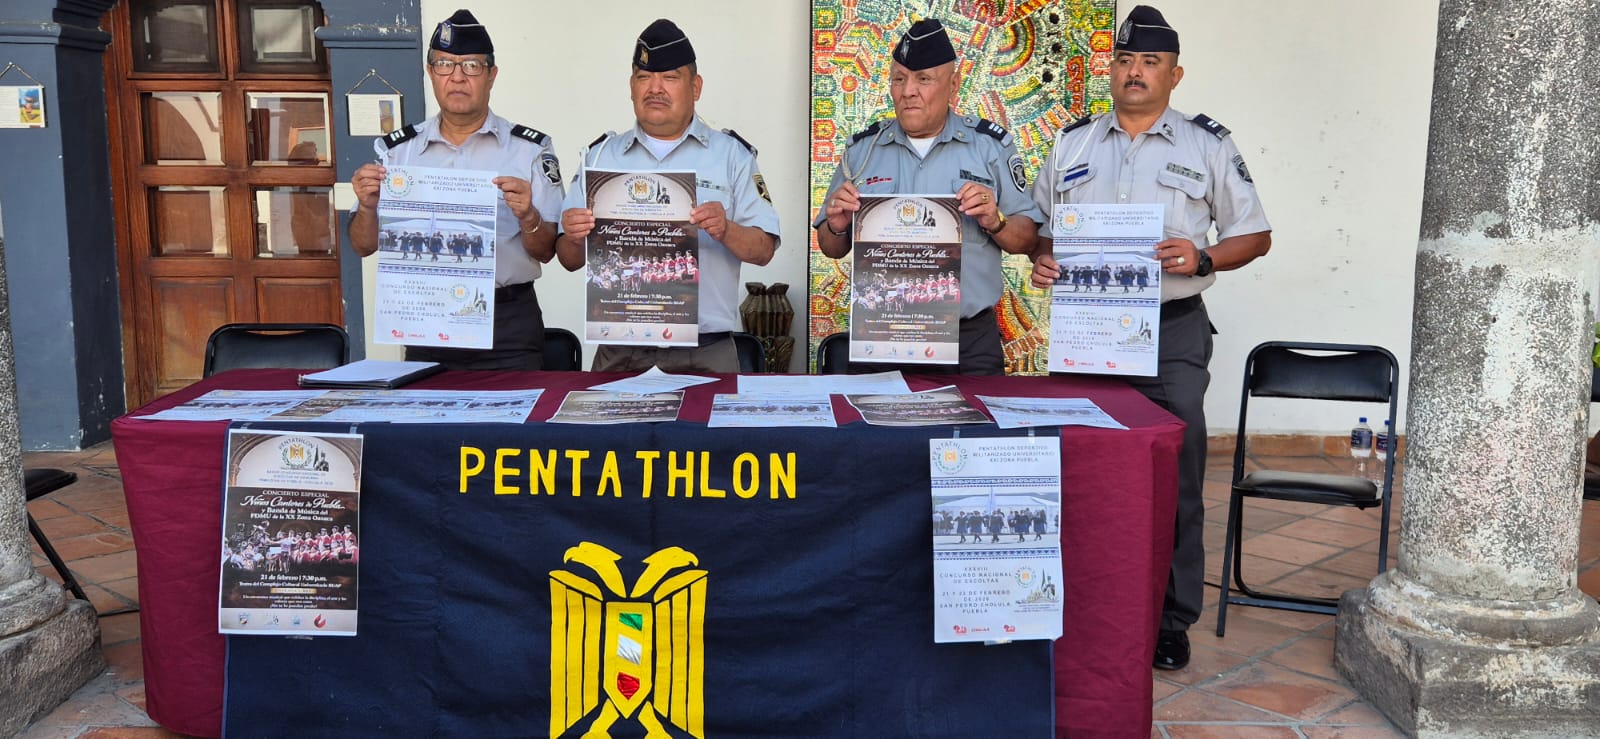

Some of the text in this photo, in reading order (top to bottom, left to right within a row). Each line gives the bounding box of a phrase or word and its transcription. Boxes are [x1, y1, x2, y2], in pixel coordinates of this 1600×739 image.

[278, 437, 315, 450] PENTATHLON
[932, 441, 968, 460] PENTATHLON
[460, 446, 796, 499] PENTATHLON
[270, 496, 304, 508] Cantores
[297, 507, 319, 515] Música
